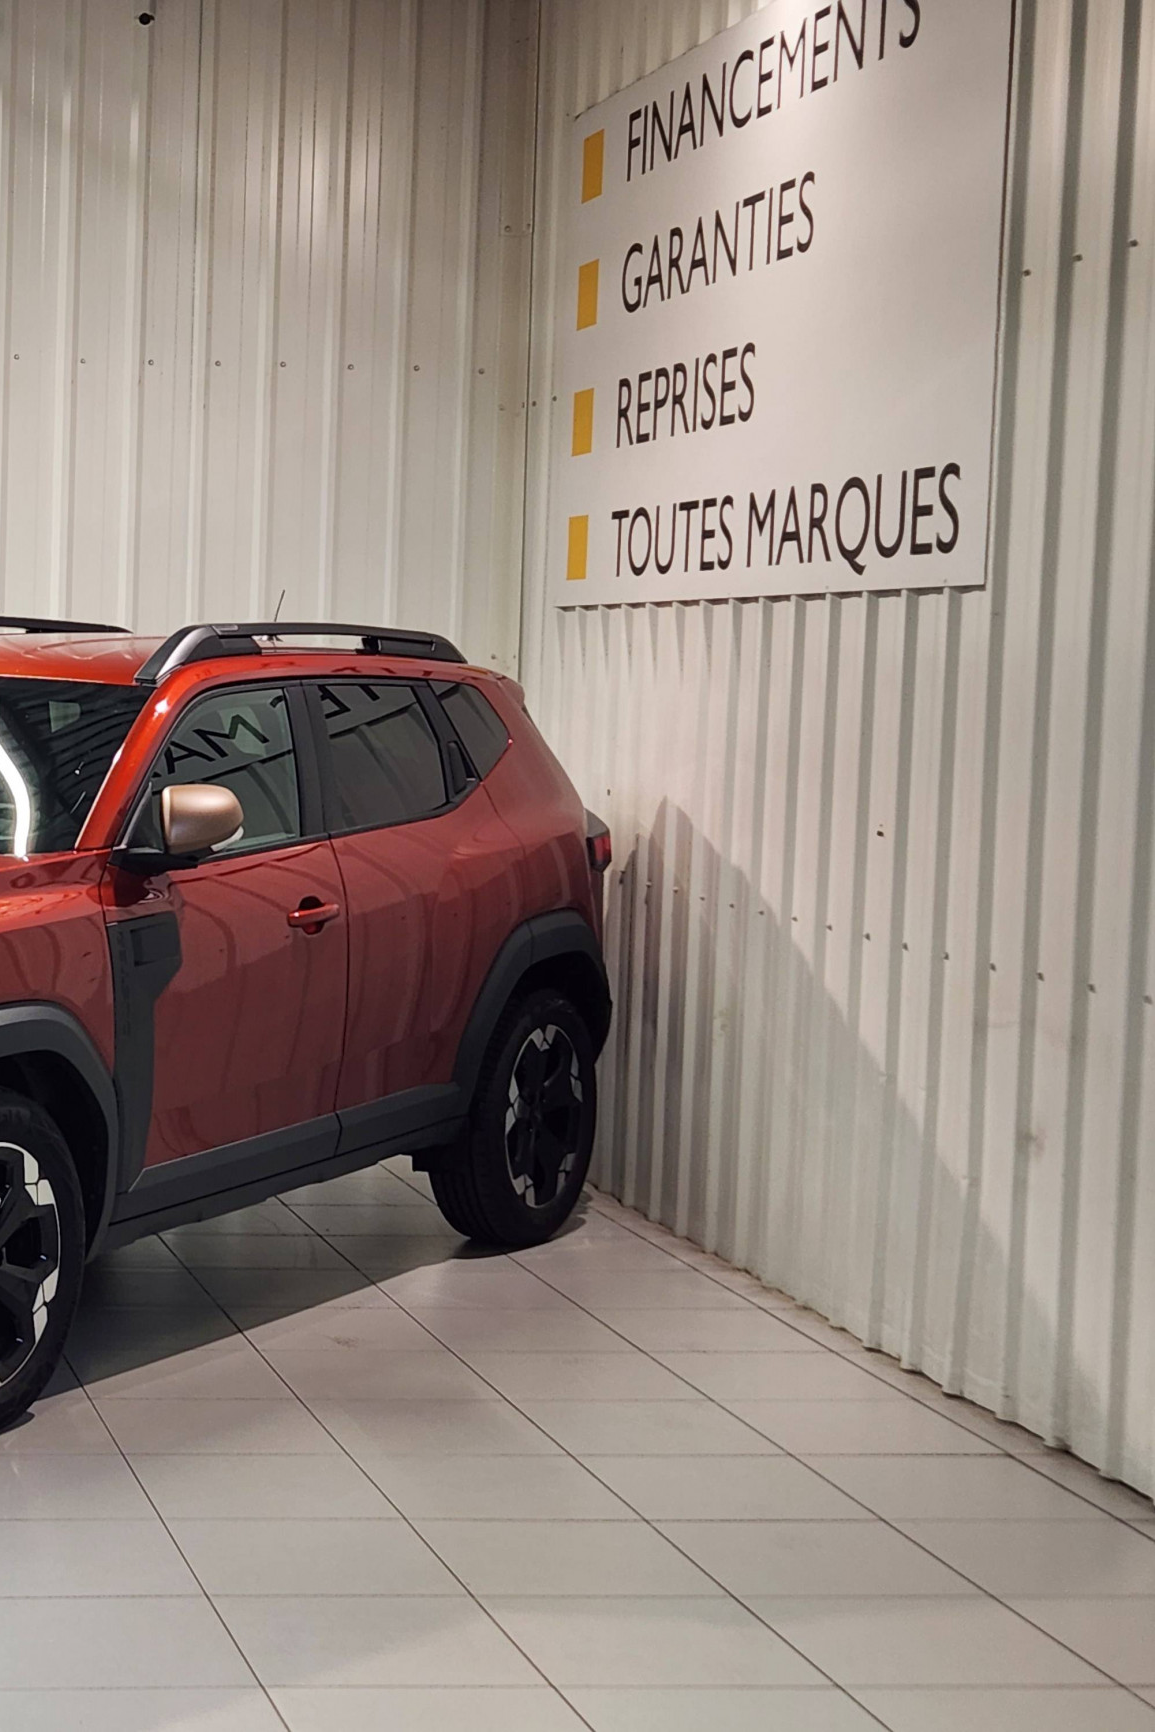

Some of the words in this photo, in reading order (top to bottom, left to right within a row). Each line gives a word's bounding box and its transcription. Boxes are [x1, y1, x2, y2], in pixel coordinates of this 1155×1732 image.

[621, 171, 815, 313] GARANTIES
[616, 342, 756, 449] REPRISES
[611, 495, 734, 577] TOUTES
[746, 462, 961, 576] MARQUES
